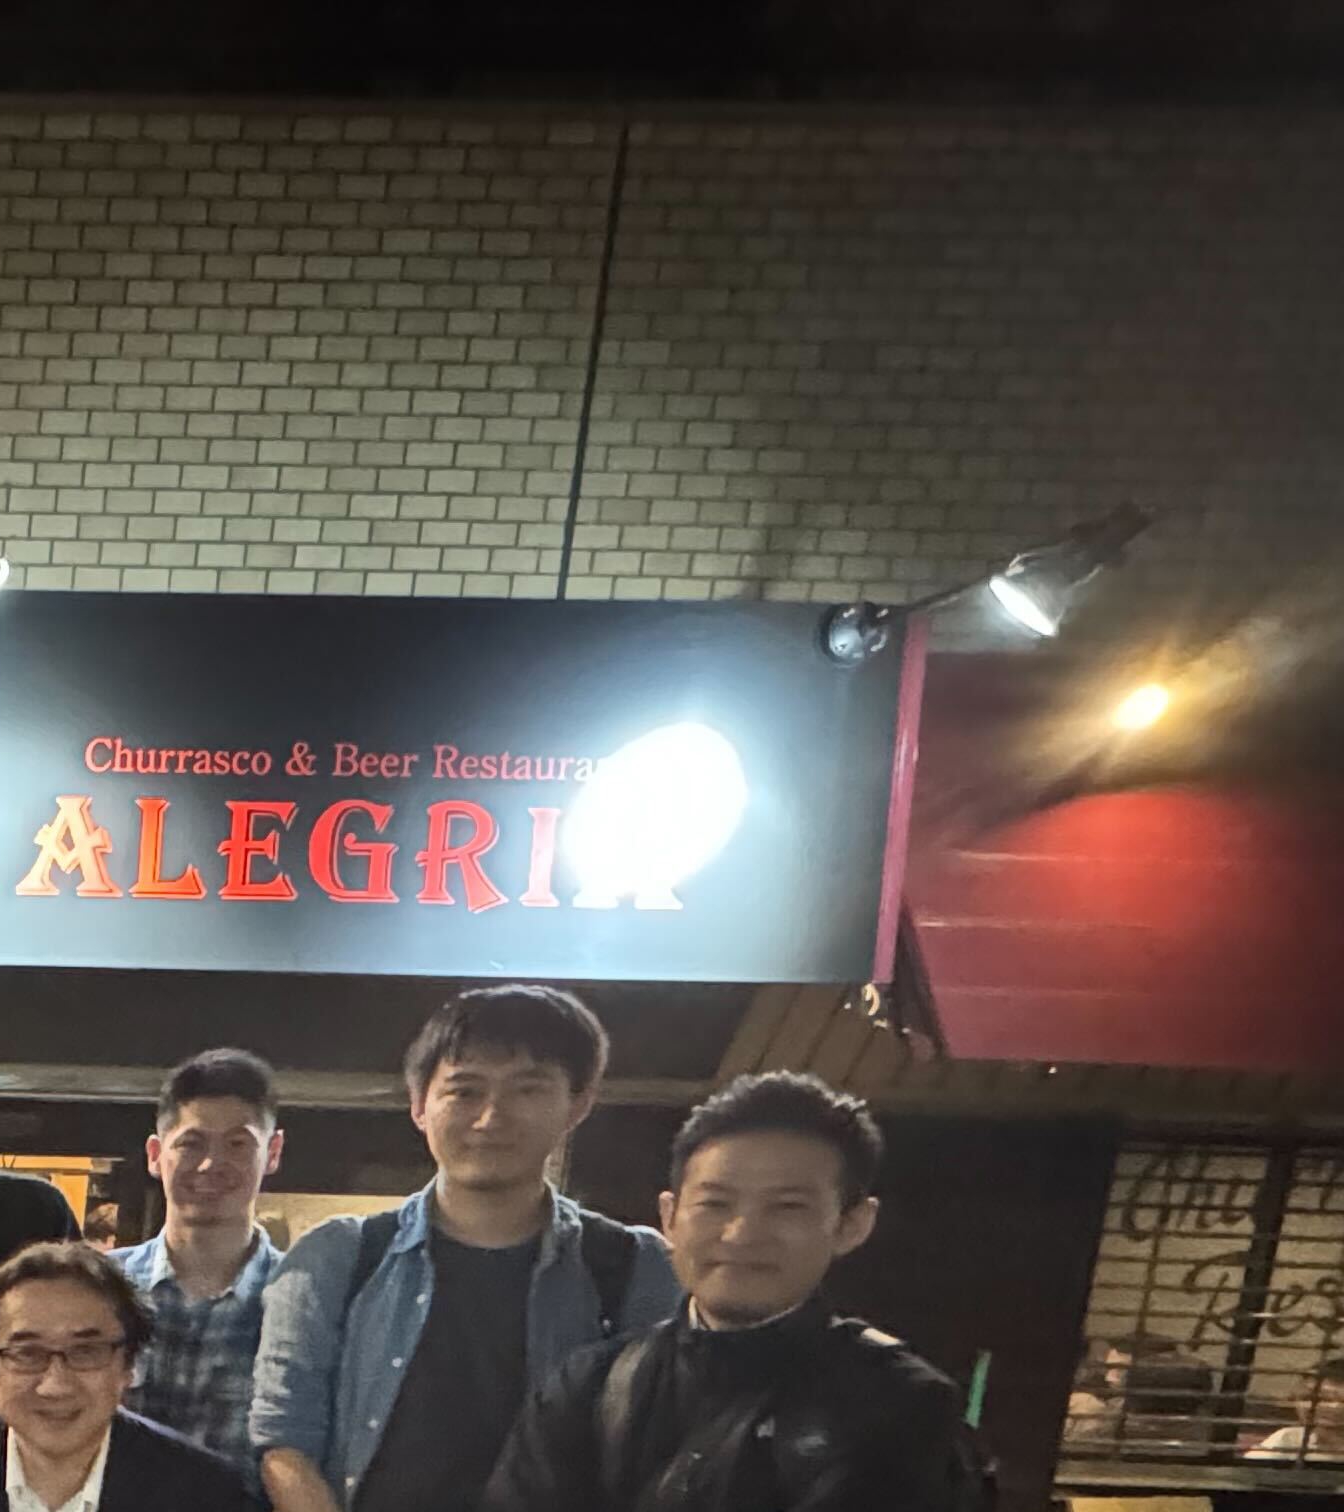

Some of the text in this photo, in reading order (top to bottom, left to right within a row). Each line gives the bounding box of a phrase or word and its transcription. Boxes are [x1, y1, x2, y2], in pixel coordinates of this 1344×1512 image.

[83, 736, 608, 783] Churrasco & Beer Restaura
